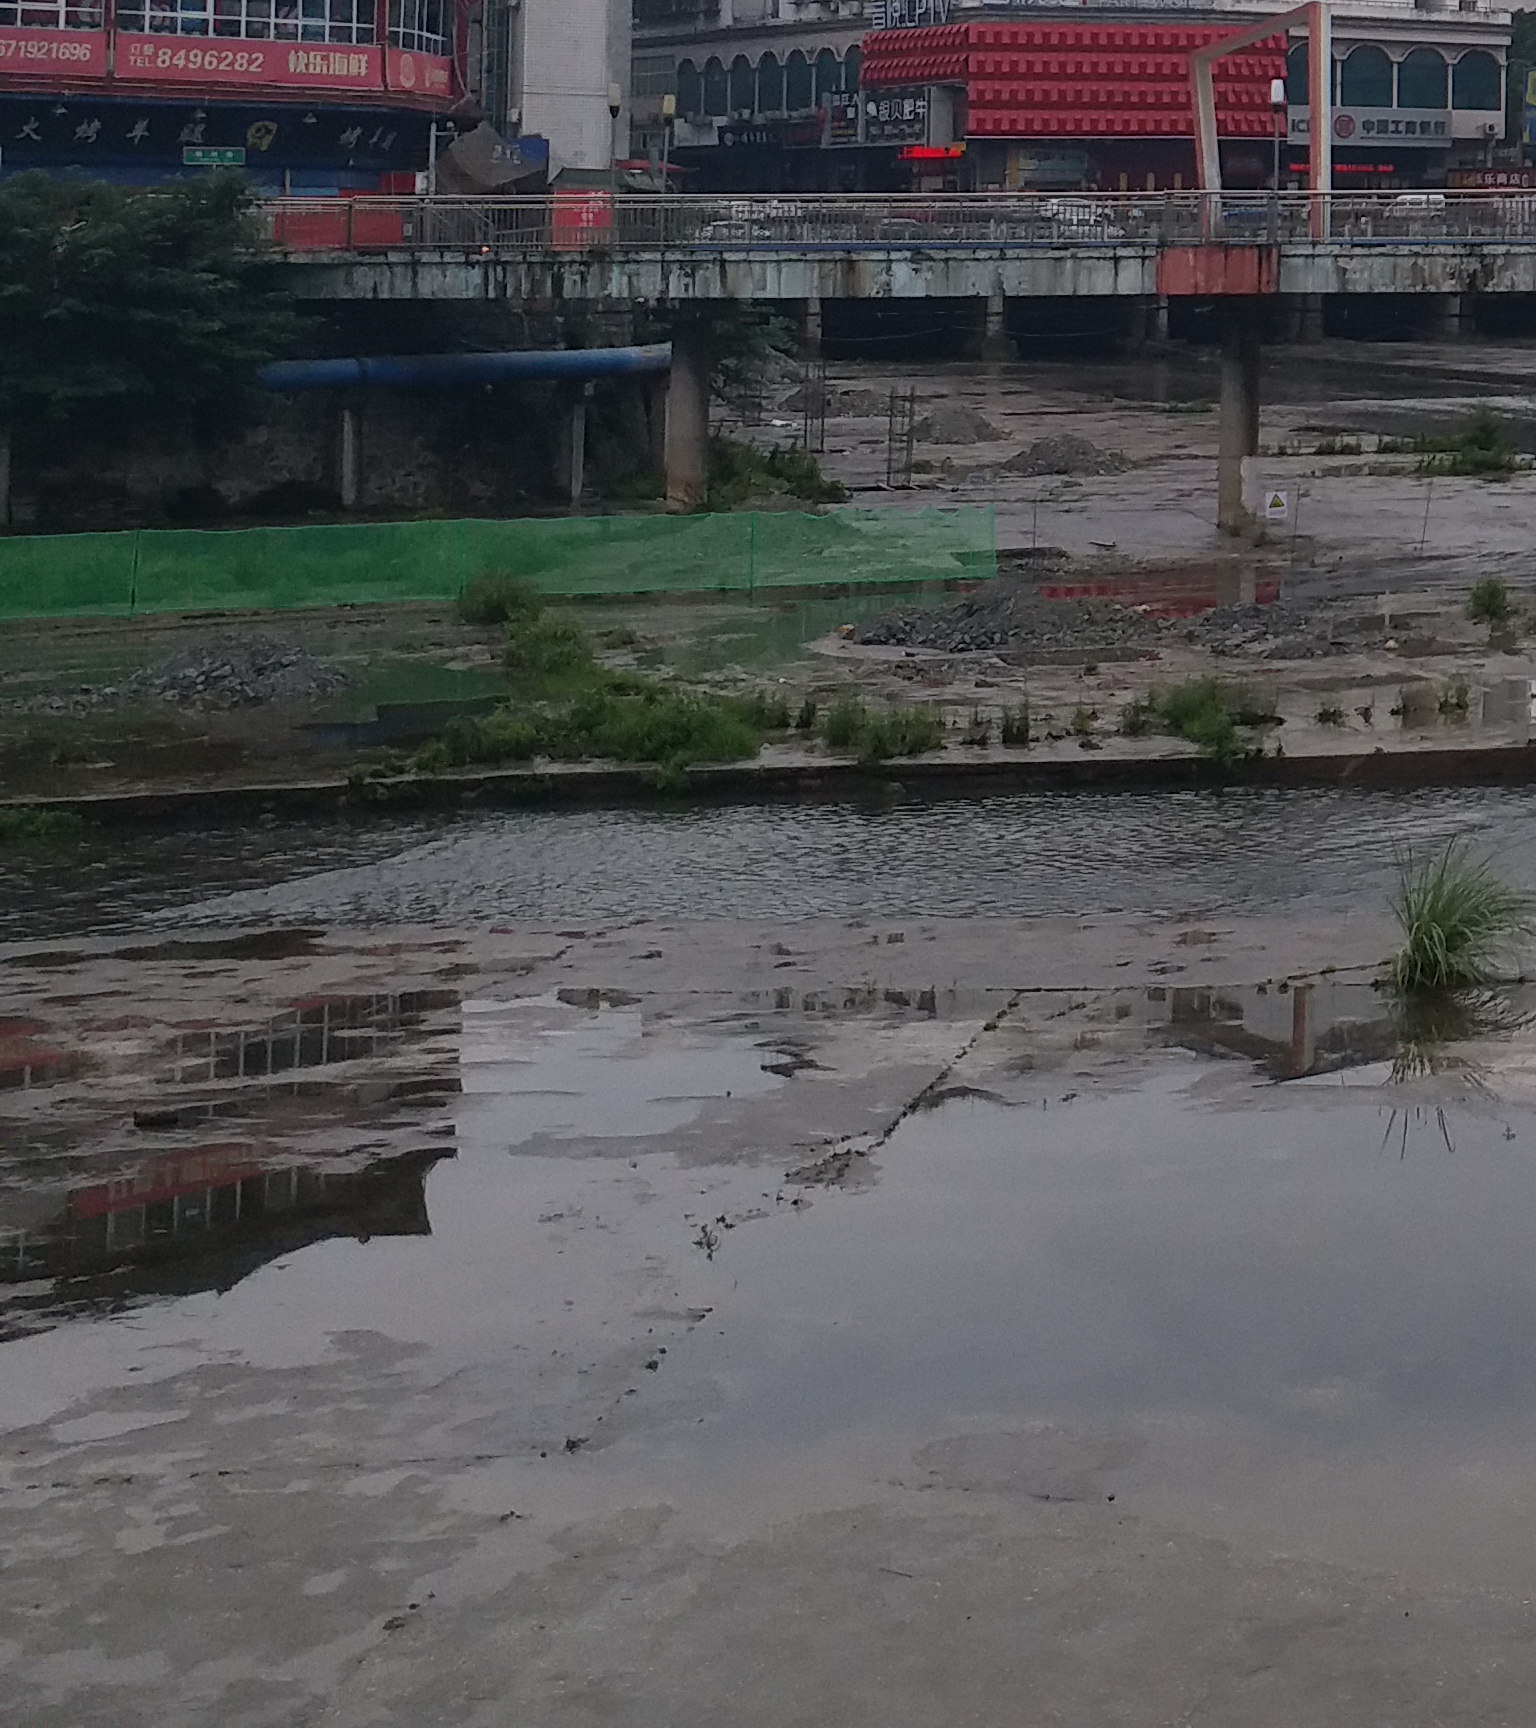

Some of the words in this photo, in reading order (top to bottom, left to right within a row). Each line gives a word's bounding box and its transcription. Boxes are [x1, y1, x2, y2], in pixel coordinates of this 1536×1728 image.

[129, 56, 153, 68] TEL
[156, 48, 264, 72] 8496282
[288, 50, 368, 76] 快乐海鲜
[1291, 118, 1310, 133] IC
